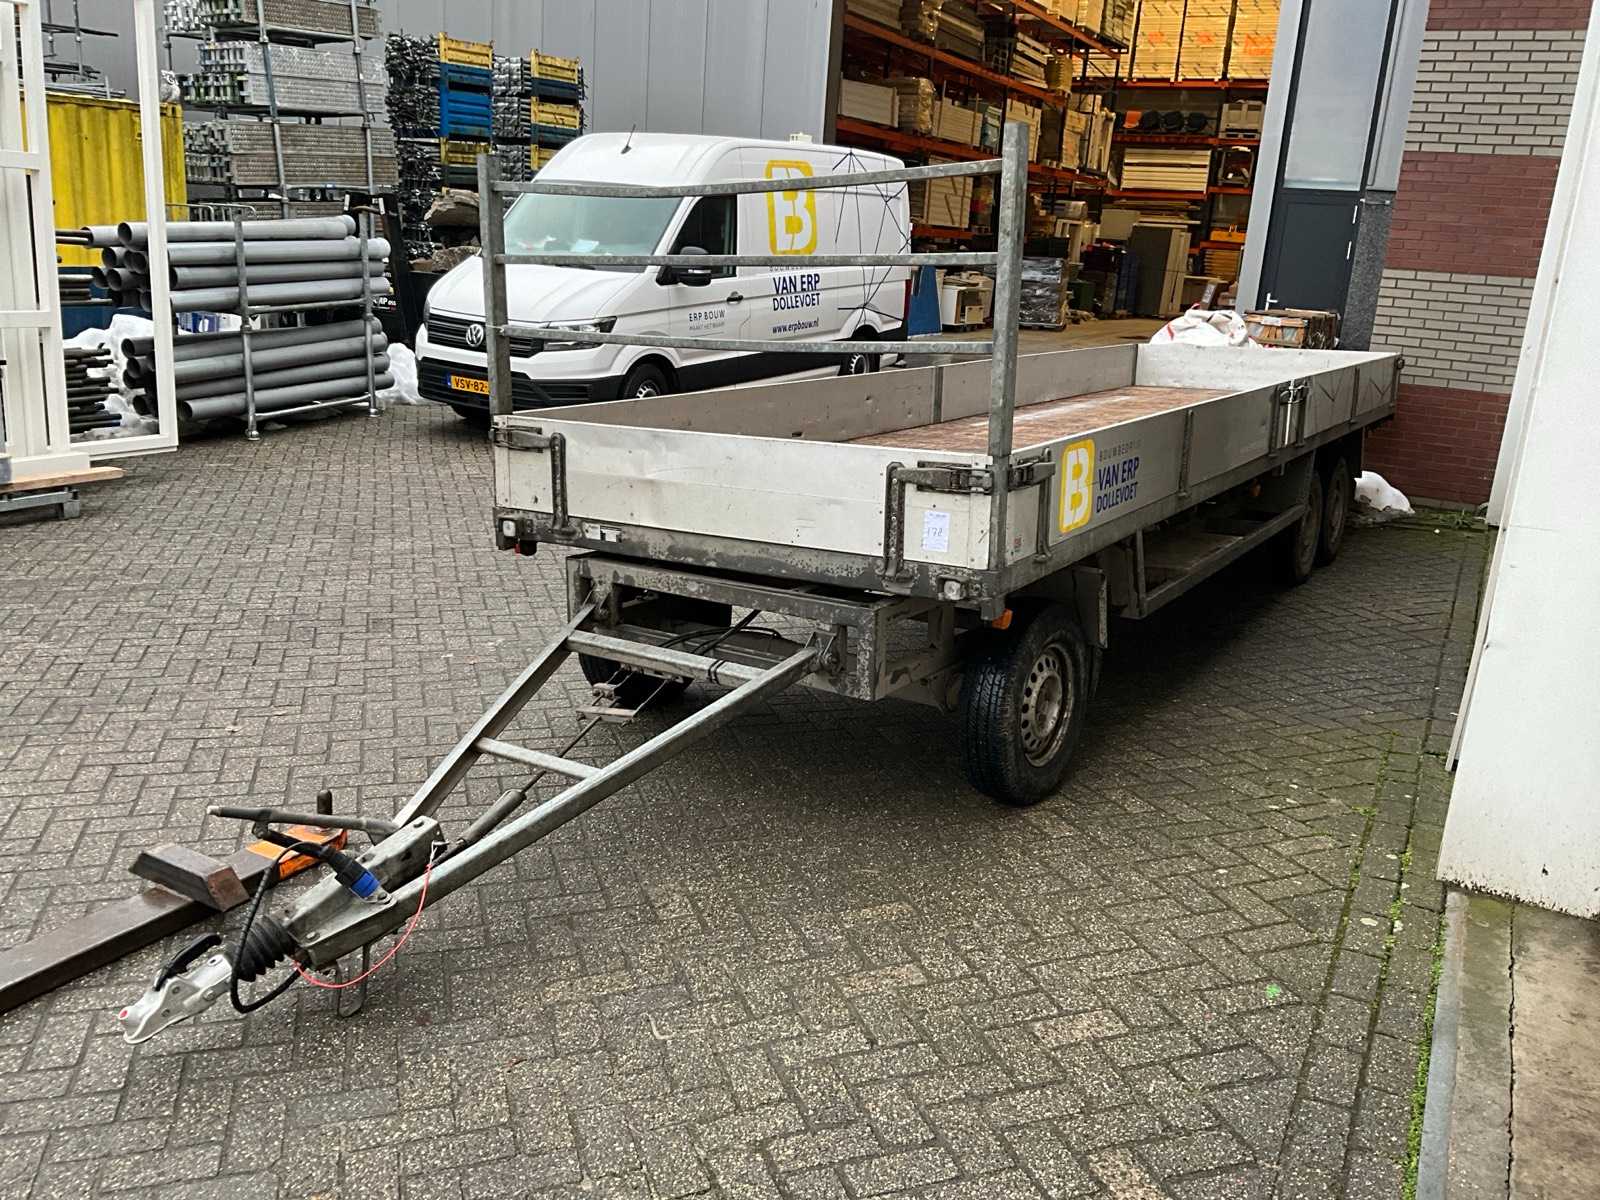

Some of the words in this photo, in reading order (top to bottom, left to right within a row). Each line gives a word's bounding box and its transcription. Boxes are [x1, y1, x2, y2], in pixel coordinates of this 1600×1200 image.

[773, 275, 797, 295] VAN
[800, 273, 820, 292] ERP
[772, 292, 820, 311] DOLLEVOET
[689, 311, 702, 321] ERP
[704, 309, 725, 320] BOUW
[772, 317, 819, 333] www.erpbouw.nl
[1098, 464, 1119, 490] VAN
[1122, 457, 1139, 483] ERP
[1096, 481, 1138, 513] DOLLEVOET
